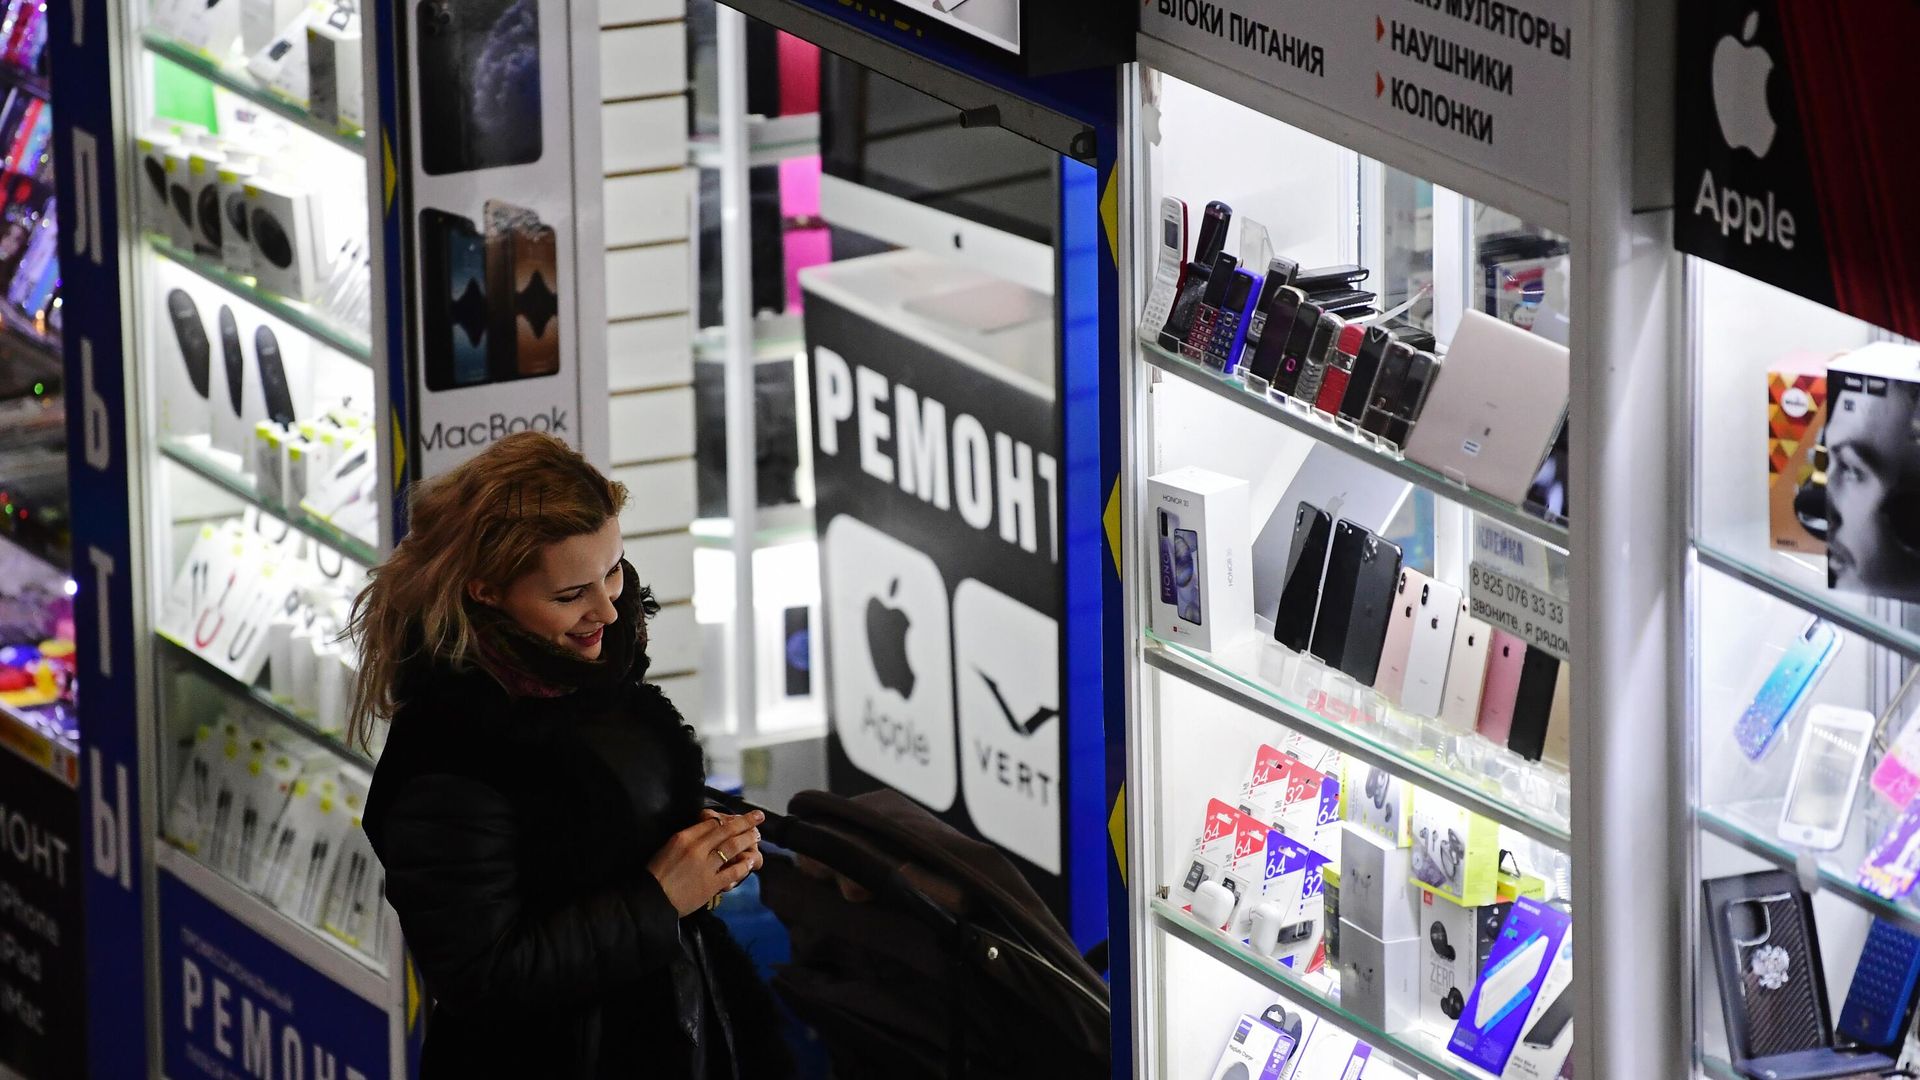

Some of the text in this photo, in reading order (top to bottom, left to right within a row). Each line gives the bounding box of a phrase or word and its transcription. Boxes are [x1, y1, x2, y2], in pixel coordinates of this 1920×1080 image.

[1230, 12, 1325, 77] ПИТАНИЯ
[1404, 0, 1571, 60] МУЛЯТОРЫ
[1391, 19, 1513, 96] НАУШНИКИ
[1391, 76, 1493, 145] КОЛОНКИ
[1694, 168, 1796, 250] Apple
[420, 405, 567, 452] MacBook
[814, 345, 1059, 565] РЕМОНТ
[1472, 567, 1564, 625] 8 925 076 33 33
[1472, 598, 1522, 633] звоните,
[1525, 622, 1533, 634] я
[1252, 766, 1270, 787] 64
[1285, 784, 1305, 806] 32
[1203, 820, 1221, 842] 64
[1317, 801, 1340, 825] 64
[0, 800, 69, 889] ОНТ
[1235, 837, 1252, 858] 64
[1265, 854, 1287, 879] 64
[1302, 874, 1324, 899] 32
[182, 956, 368, 1080] РЕМО
